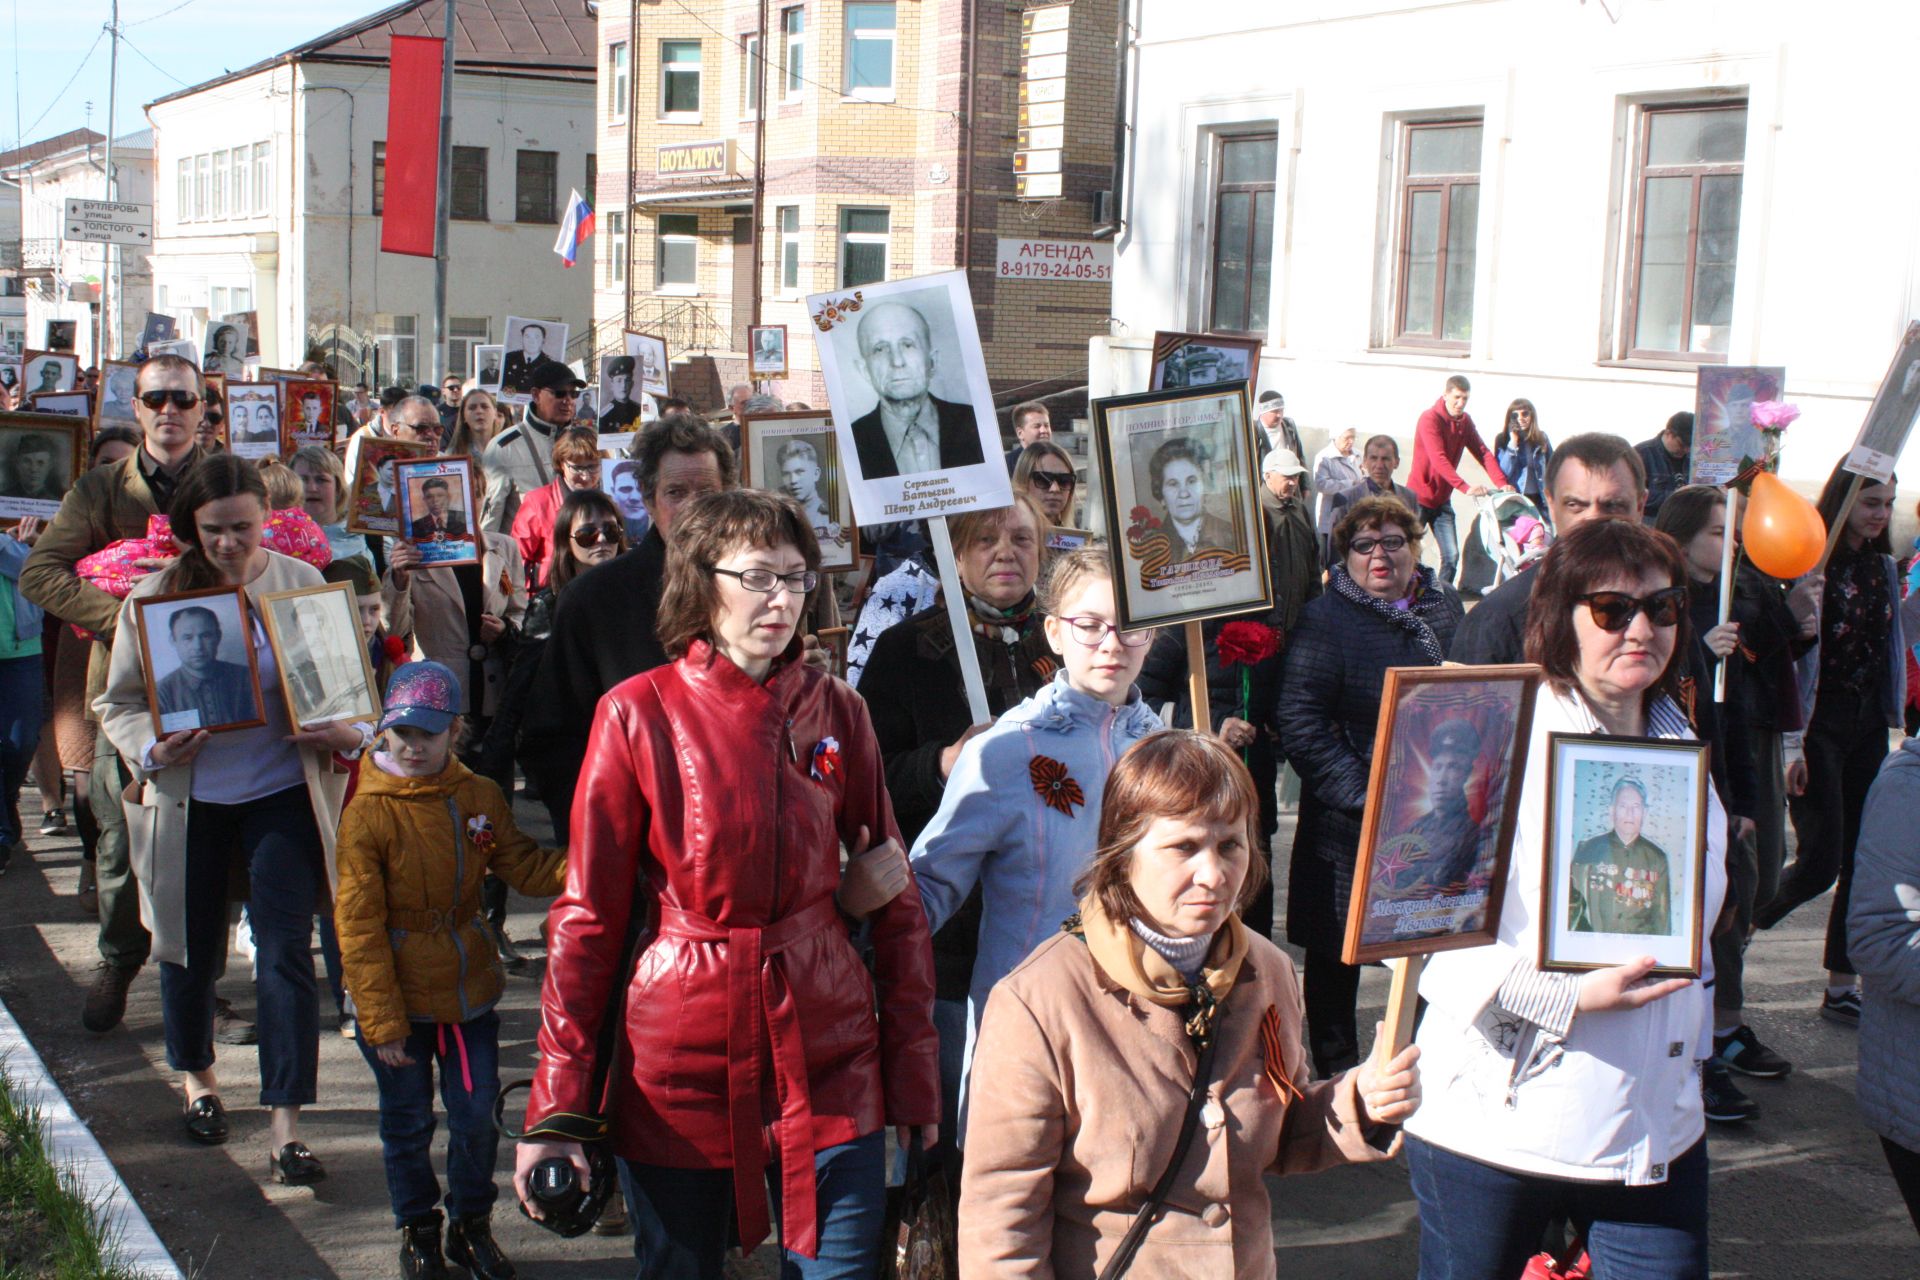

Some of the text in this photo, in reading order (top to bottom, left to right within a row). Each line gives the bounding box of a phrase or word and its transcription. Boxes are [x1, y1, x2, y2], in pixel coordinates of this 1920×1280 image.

[660, 145, 723, 171] НОТАРИУС
[83, 202, 139, 213] БУТЛЕРОВА
[84, 211, 112, 219] улица
[84, 222, 134, 233] ТОЛСТОГО
[84, 232, 112, 240] улица
[1019, 243, 1094, 262] АРЕНДА
[1001, 261, 1112, 279] 8-9179-24-05-51
[904, 476, 949, 490] Сержант
[902, 486, 956, 502] Батыгин
[884, 494, 977, 515] Пётр Андреевич
